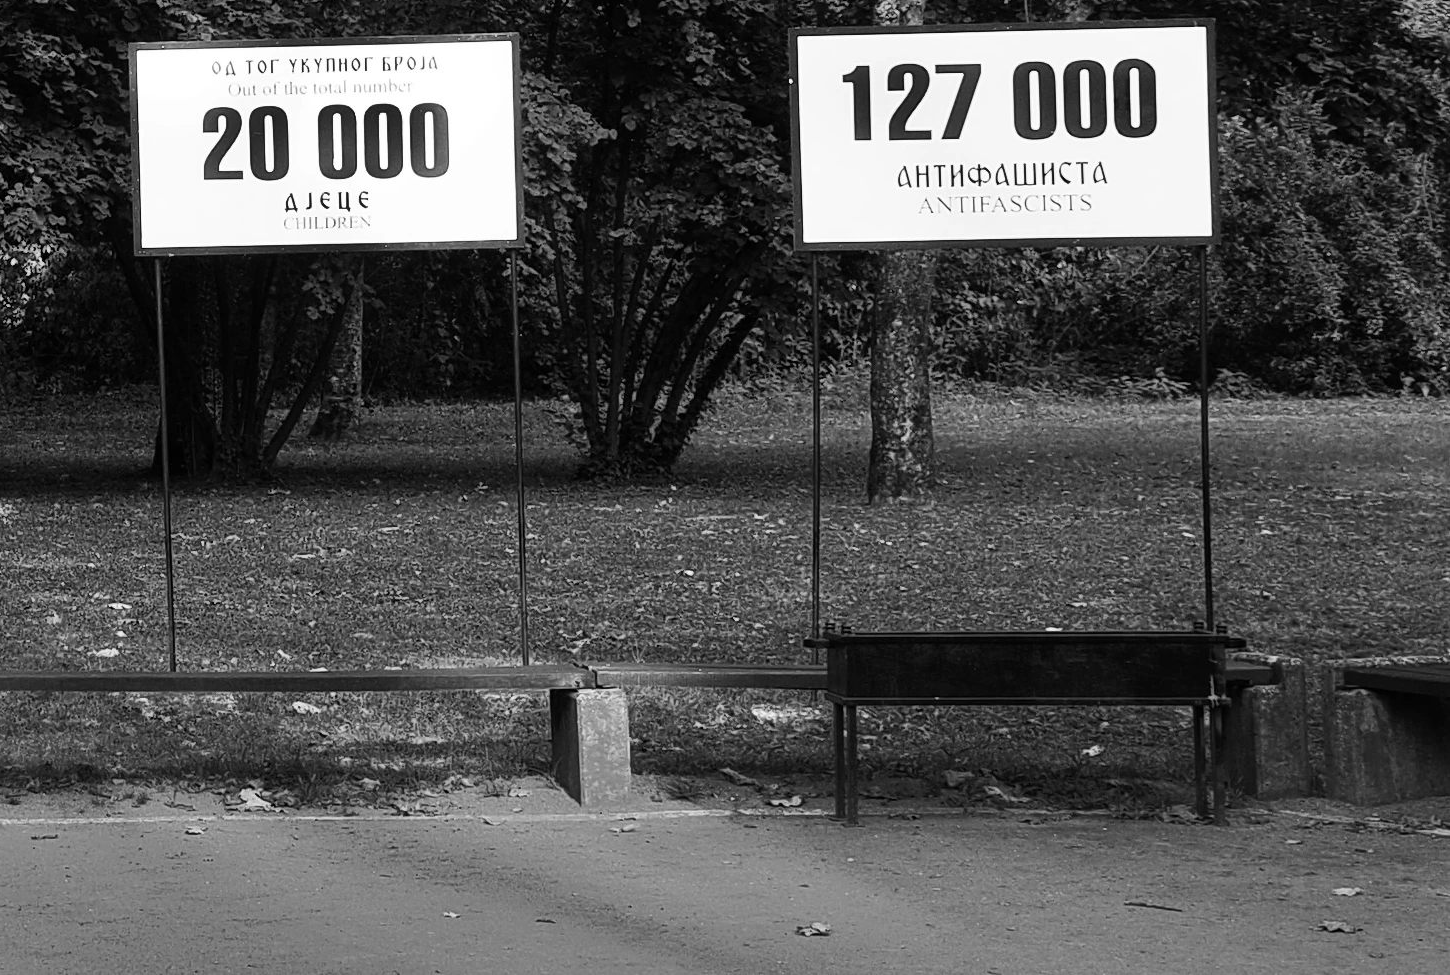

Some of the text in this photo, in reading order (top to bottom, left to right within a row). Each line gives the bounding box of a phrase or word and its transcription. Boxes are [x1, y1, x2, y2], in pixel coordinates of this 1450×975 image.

[212, 56, 438, 77] ОД ТОГ УКУПНОГ БРОЈА
[228, 79, 412, 96] Out of the total number
[842, 58, 1158, 141] 127 000
[202, 102, 449, 181] 20 000
[897, 161, 1108, 188] АНТИФАШИСТА
[284, 191, 369, 213] ДЈЕЦЕ
[918, 193, 1092, 214] ANTIFASCISTS
[284, 215, 371, 230] CHILDREN
